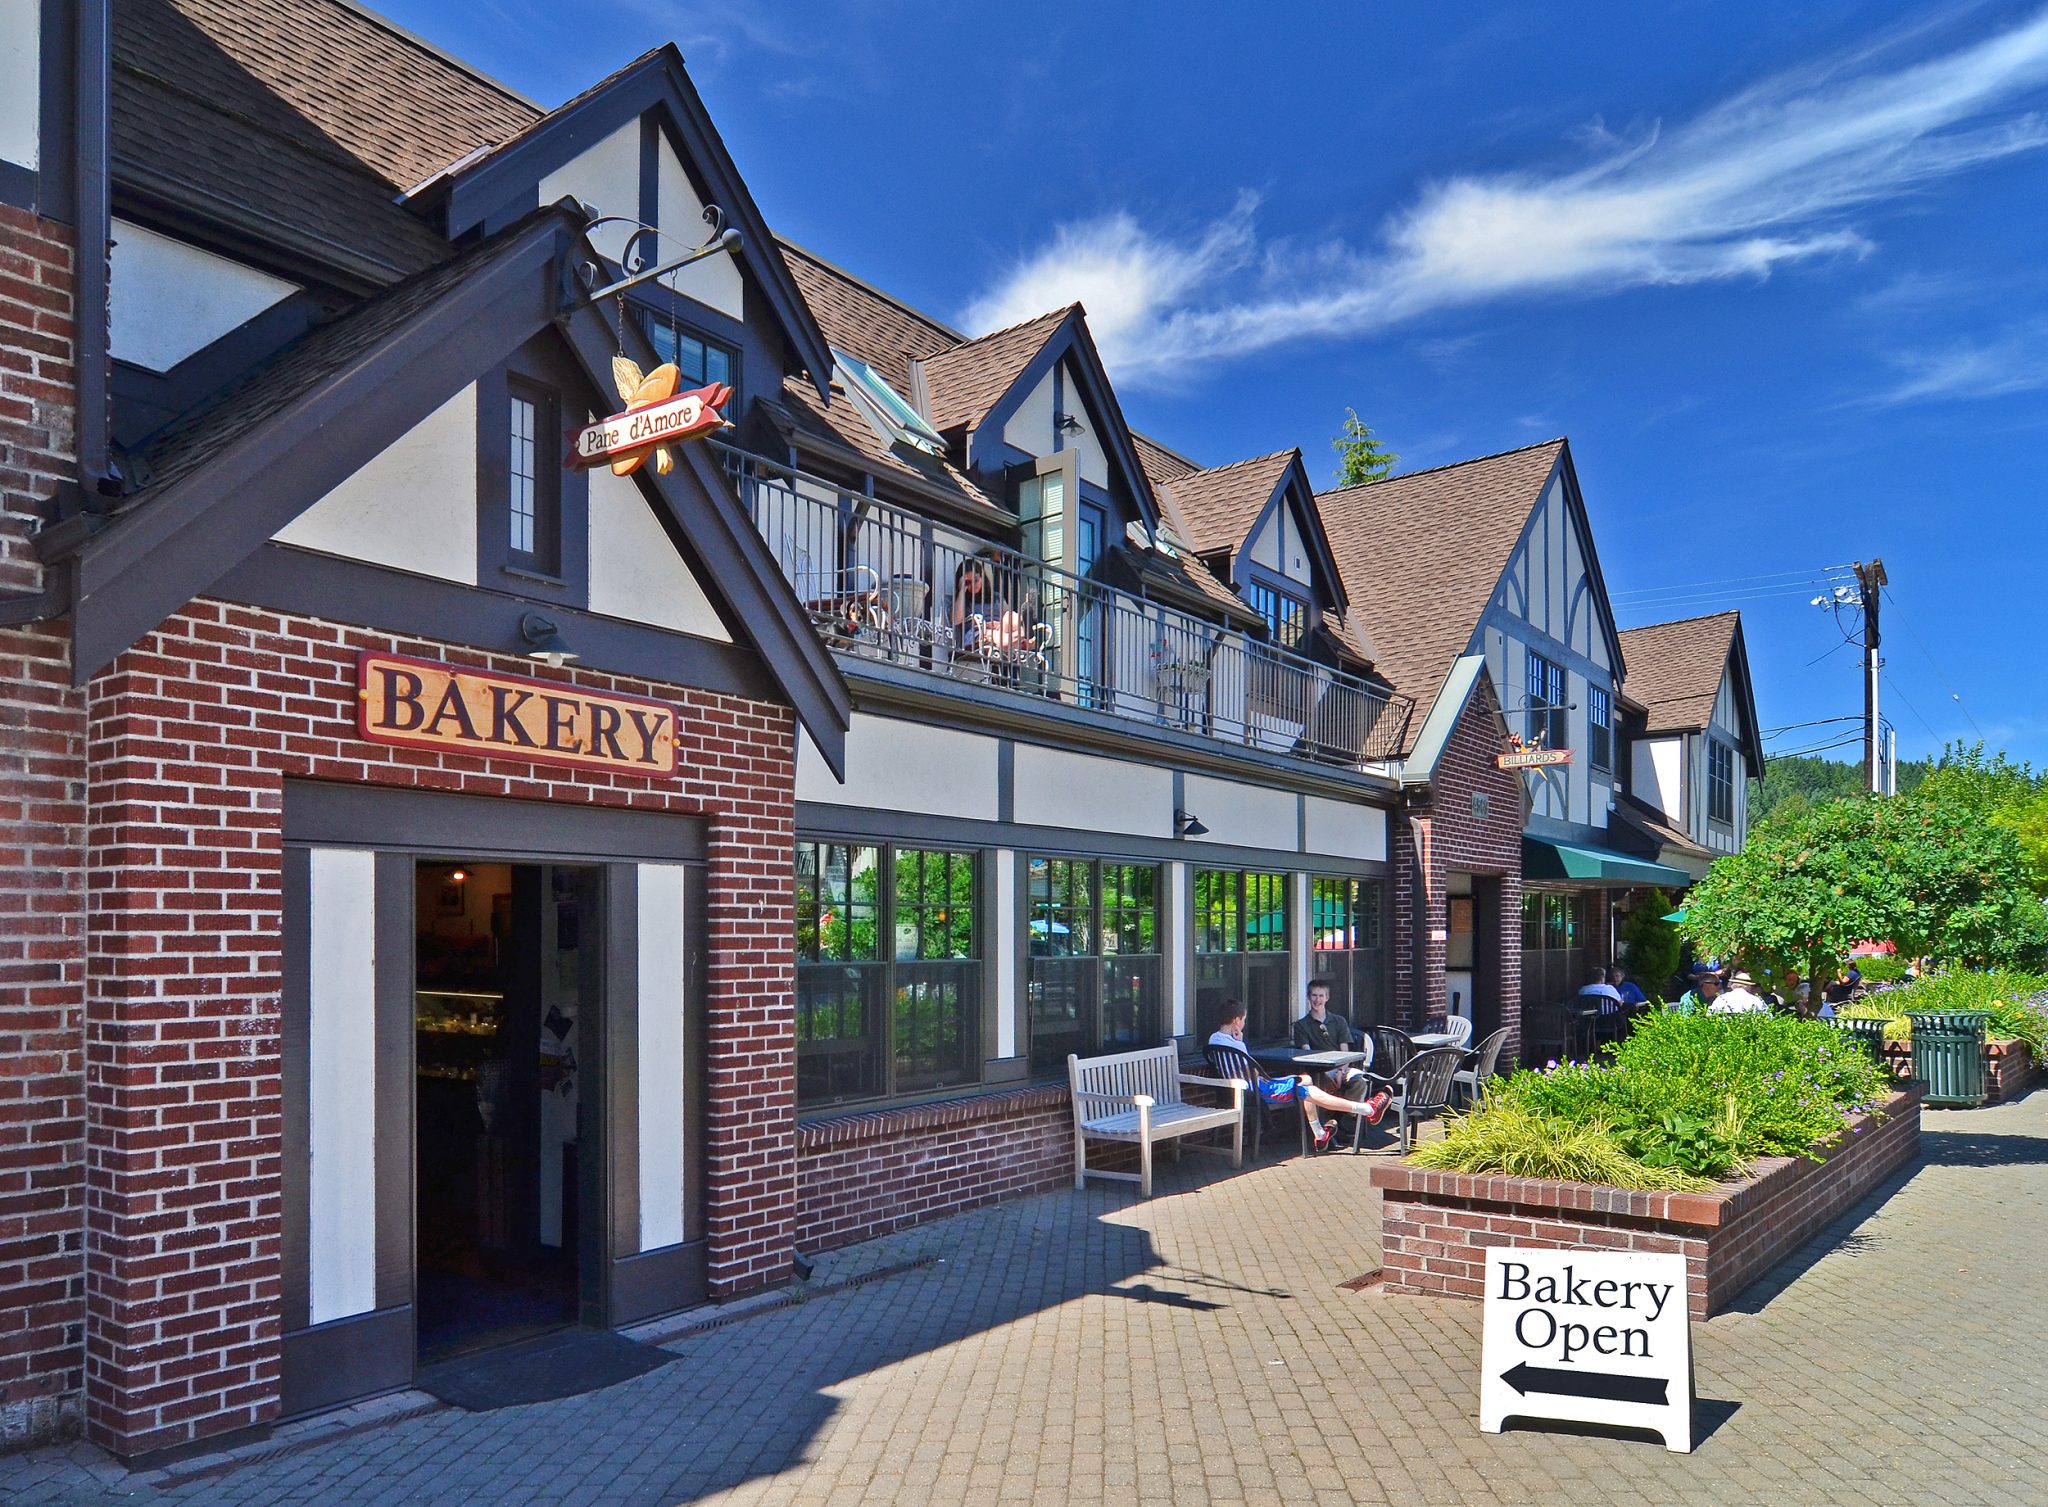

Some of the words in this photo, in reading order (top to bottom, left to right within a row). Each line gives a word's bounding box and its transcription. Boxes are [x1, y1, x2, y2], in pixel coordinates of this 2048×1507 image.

[586, 429, 620, 453] Pane
[629, 406, 693, 441] d'Amore
[372, 666, 669, 765] BAKERY
[1503, 753, 1557, 766] BILLIARDS
[1497, 1261, 1674, 1322] Bakery
[1515, 1308, 1654, 1363] Open
